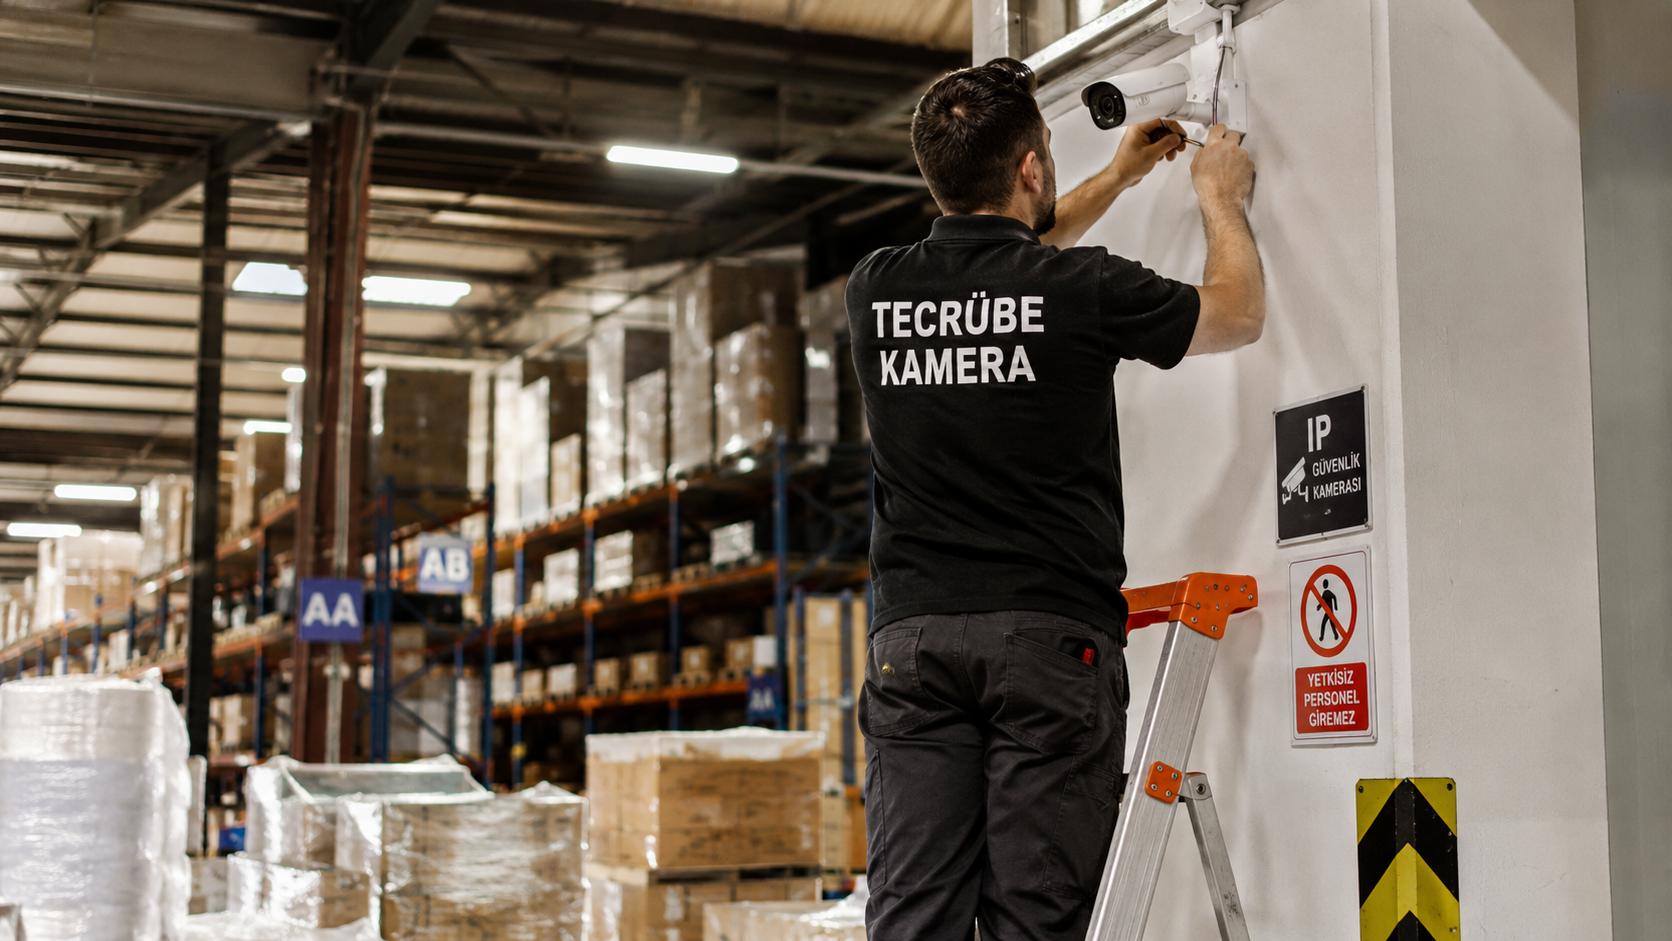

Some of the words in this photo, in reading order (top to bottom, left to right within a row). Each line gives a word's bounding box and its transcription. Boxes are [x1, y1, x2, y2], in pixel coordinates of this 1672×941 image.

[872, 291, 1045, 338] TECRÜBE
[879, 345, 1036, 386] KAMERA
[1307, 414, 1332, 452] IP
[1312, 452, 1361, 477] GÜVENLİK
[1313, 477, 1361, 500] KAMERASI
[420, 547, 469, 582] AB
[302, 592, 359, 627] AA
[1307, 667, 1354, 688] YETKİSİZ
[1304, 690, 1360, 707] PERSONEL
[1309, 709, 1356, 727] GİREMEZ
